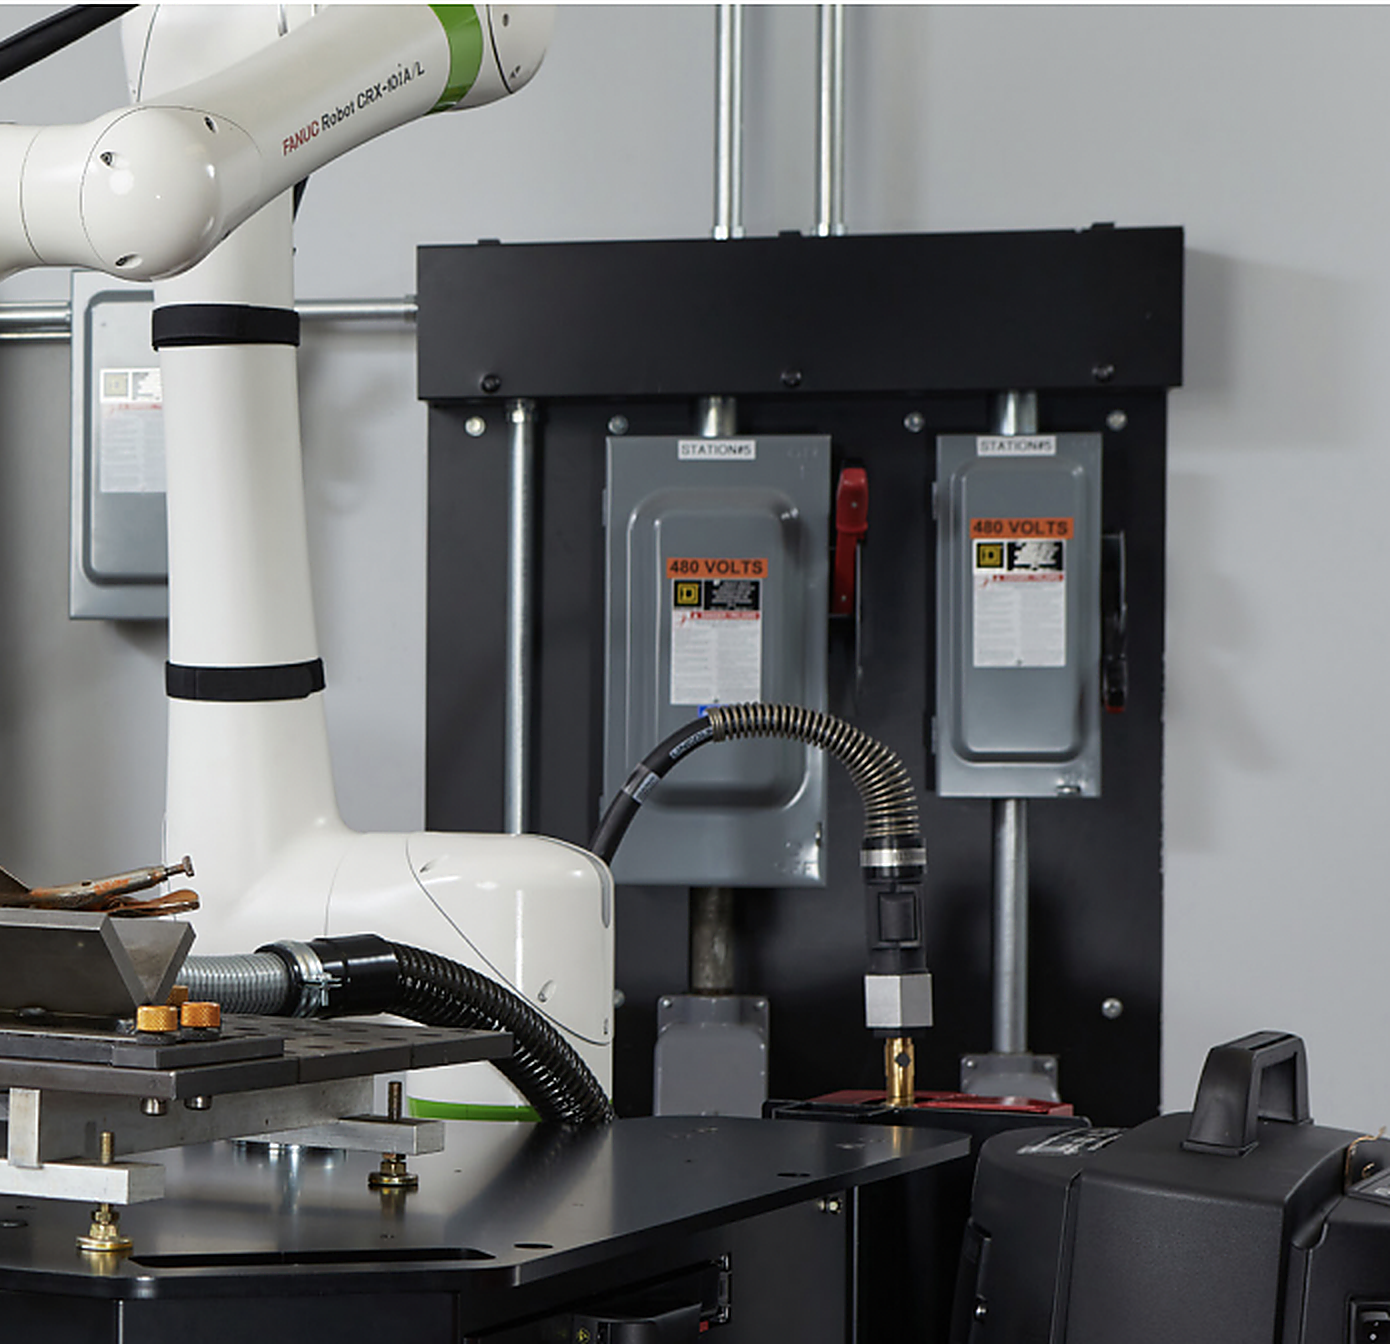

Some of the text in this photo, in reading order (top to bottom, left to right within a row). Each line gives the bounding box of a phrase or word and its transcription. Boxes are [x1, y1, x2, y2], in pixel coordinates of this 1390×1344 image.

[282, 120, 320, 156] FANUC
[321, 101, 355, 131] Robot
[681, 443, 752, 456] STATION#5
[973, 519, 1069, 536] 480 VOLTS
[669, 559, 763, 575] 480 VOLTS
